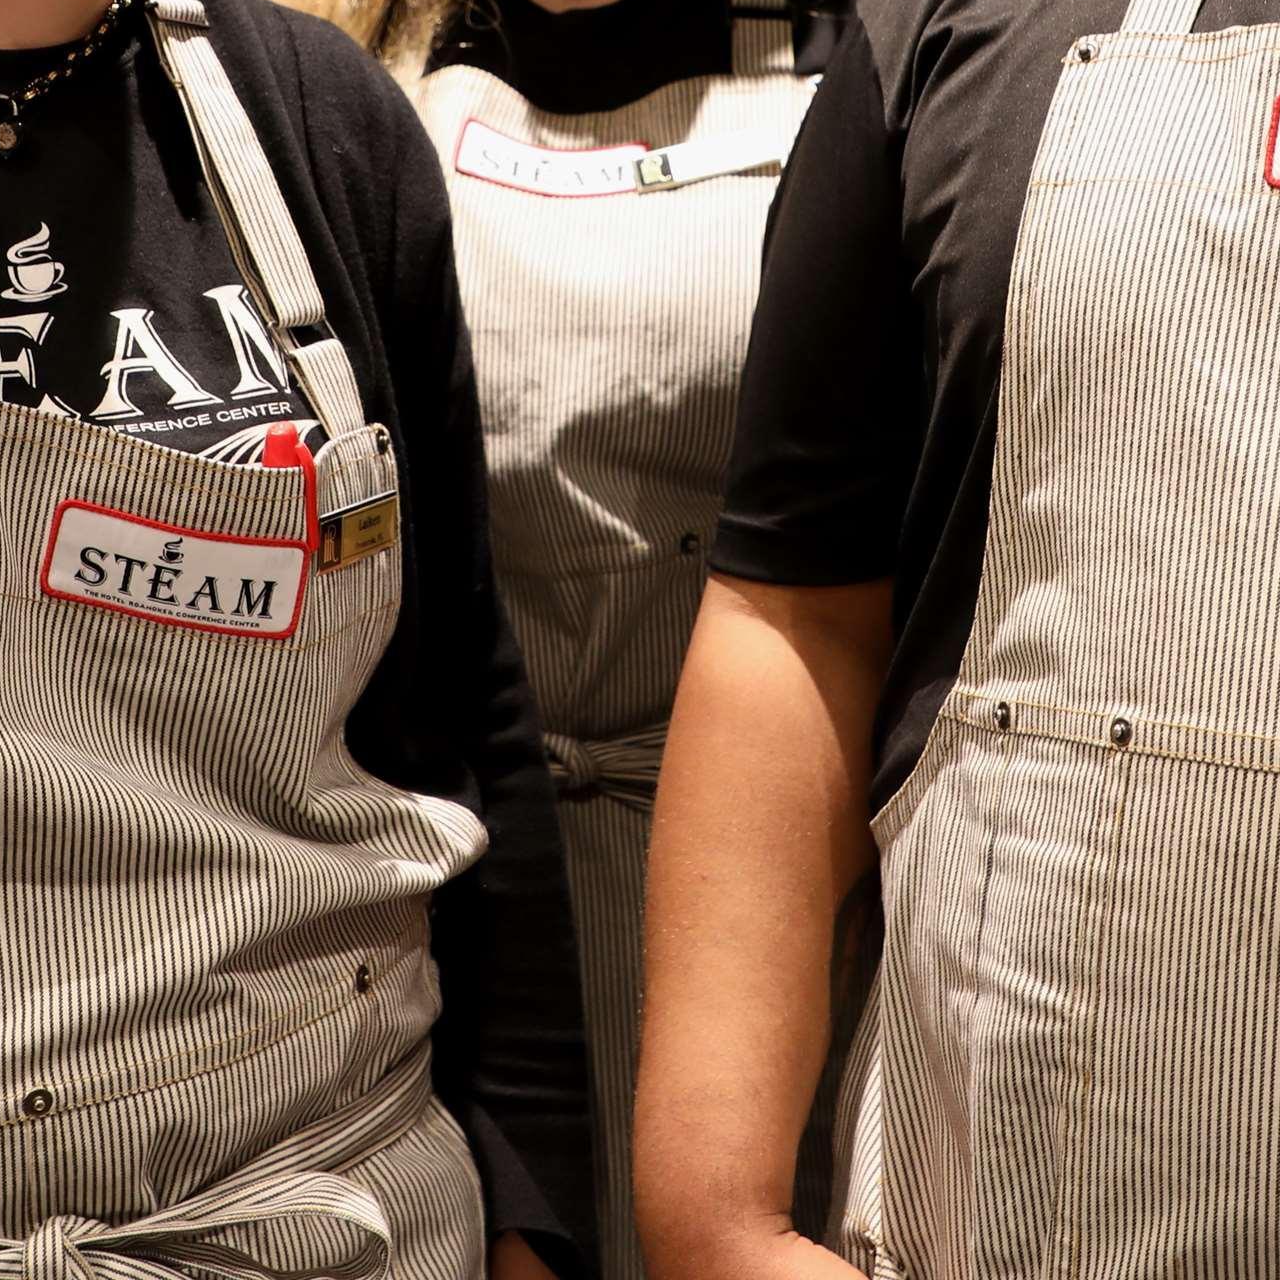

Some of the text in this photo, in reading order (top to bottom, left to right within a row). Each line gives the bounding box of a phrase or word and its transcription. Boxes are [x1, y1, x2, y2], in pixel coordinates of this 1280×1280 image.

[216, 401, 293, 422] CENTER
[74, 546, 278, 620] STEAM
[84, 588, 100, 599] THE
[101, 592, 125, 604] HOTEL
[128, 600, 168, 614] ROANOKE
[176, 610, 228, 625] CONFERENCE
[229, 619, 260, 628] CENTER
